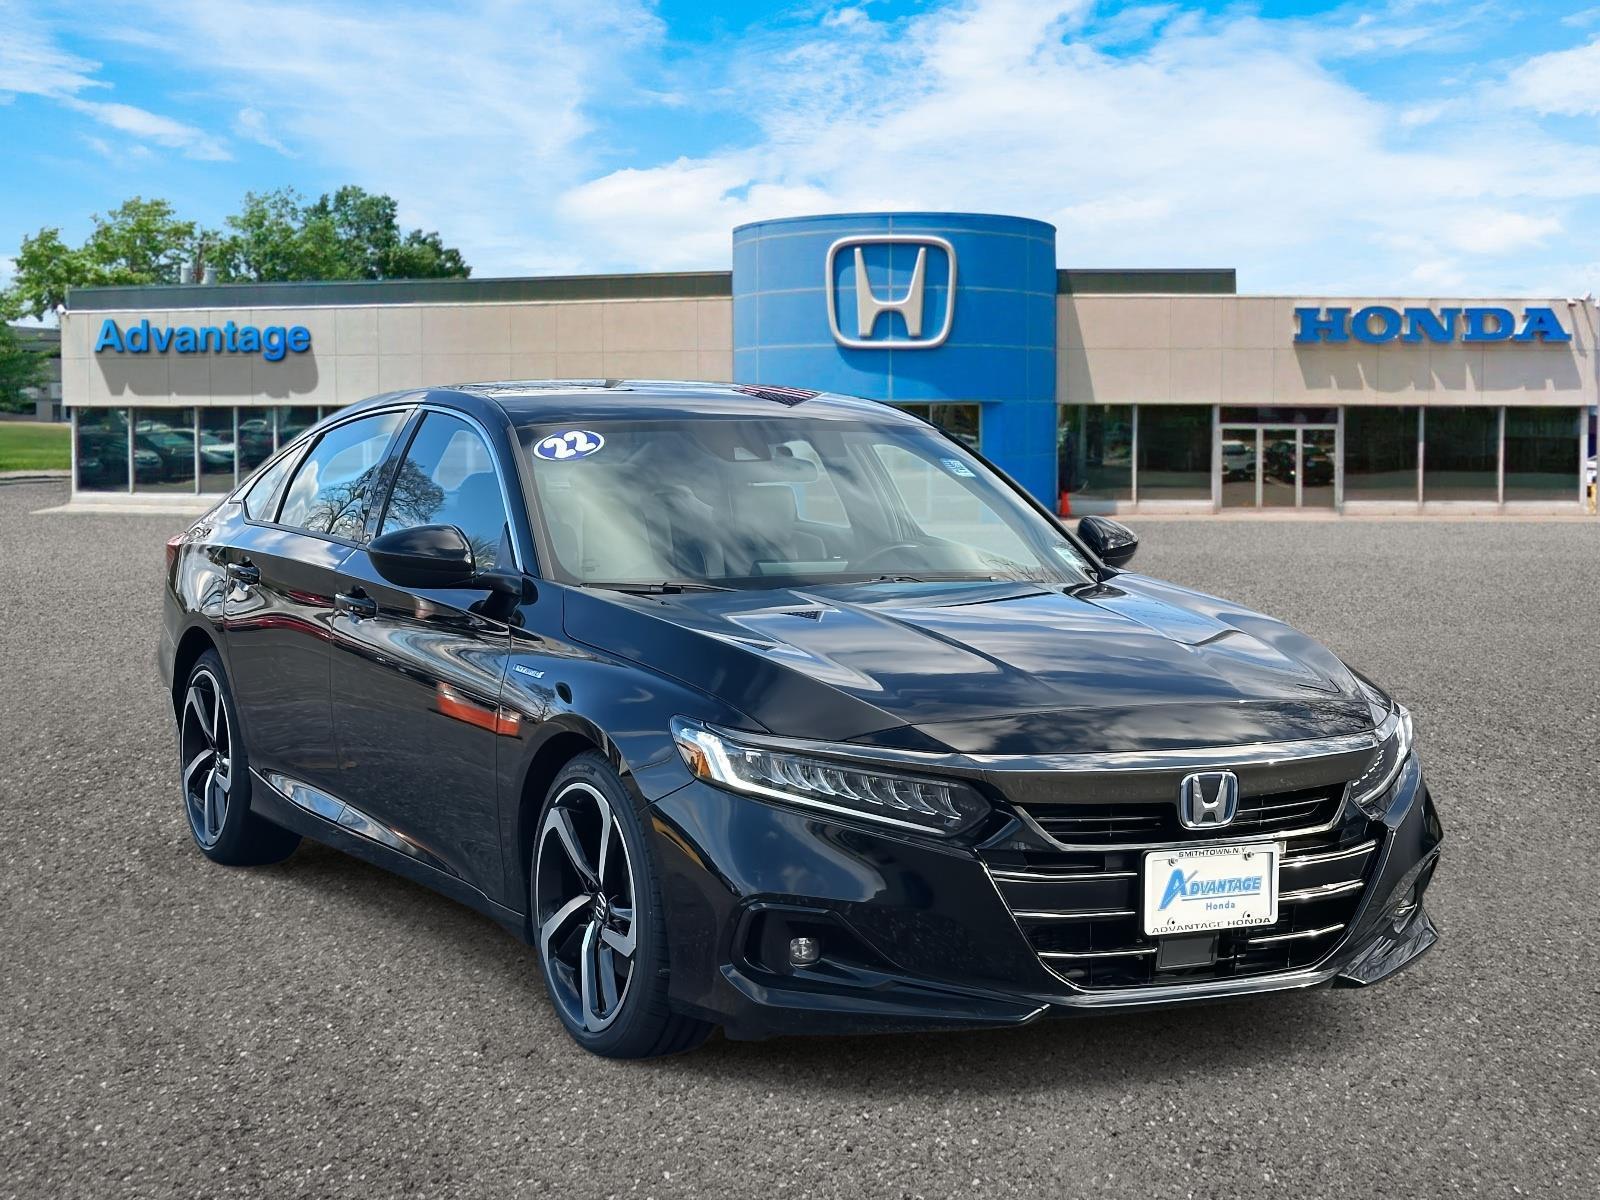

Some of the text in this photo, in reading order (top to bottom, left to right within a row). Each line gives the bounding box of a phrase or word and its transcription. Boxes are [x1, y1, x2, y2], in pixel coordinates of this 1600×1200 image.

[95, 319, 312, 362] Advantage
[1294, 306, 1573, 343] HONDA
[543, 431, 597, 459] 22
[1158, 868, 1262, 911] ADVANTAGE
[1205, 901, 1236, 911] Honda
[1152, 916, 1271, 933] ADVANTAGE HONDA
